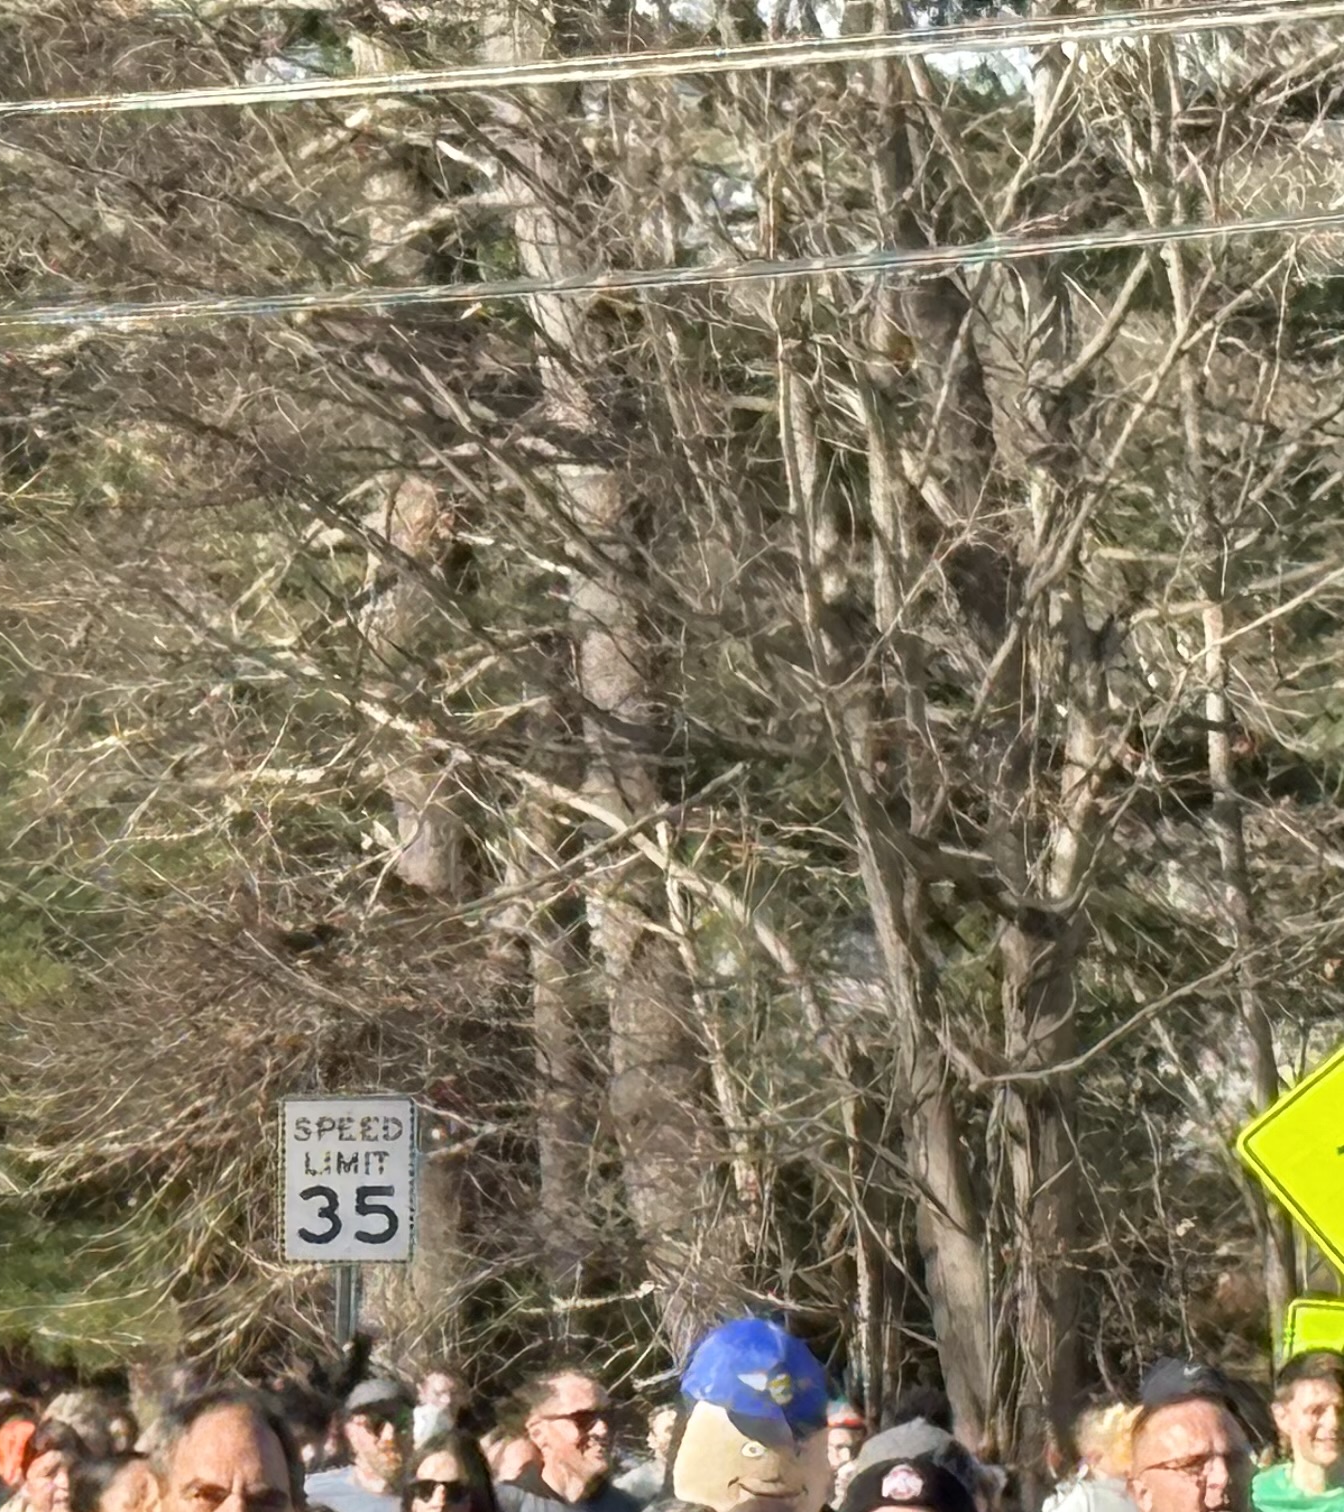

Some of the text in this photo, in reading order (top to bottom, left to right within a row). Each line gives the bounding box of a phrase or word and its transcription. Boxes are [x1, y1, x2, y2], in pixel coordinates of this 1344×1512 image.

[294, 1116, 403, 1142] SPEED
[305, 1150, 389, 1175] LIMIT
[298, 1185, 399, 1244] 35
